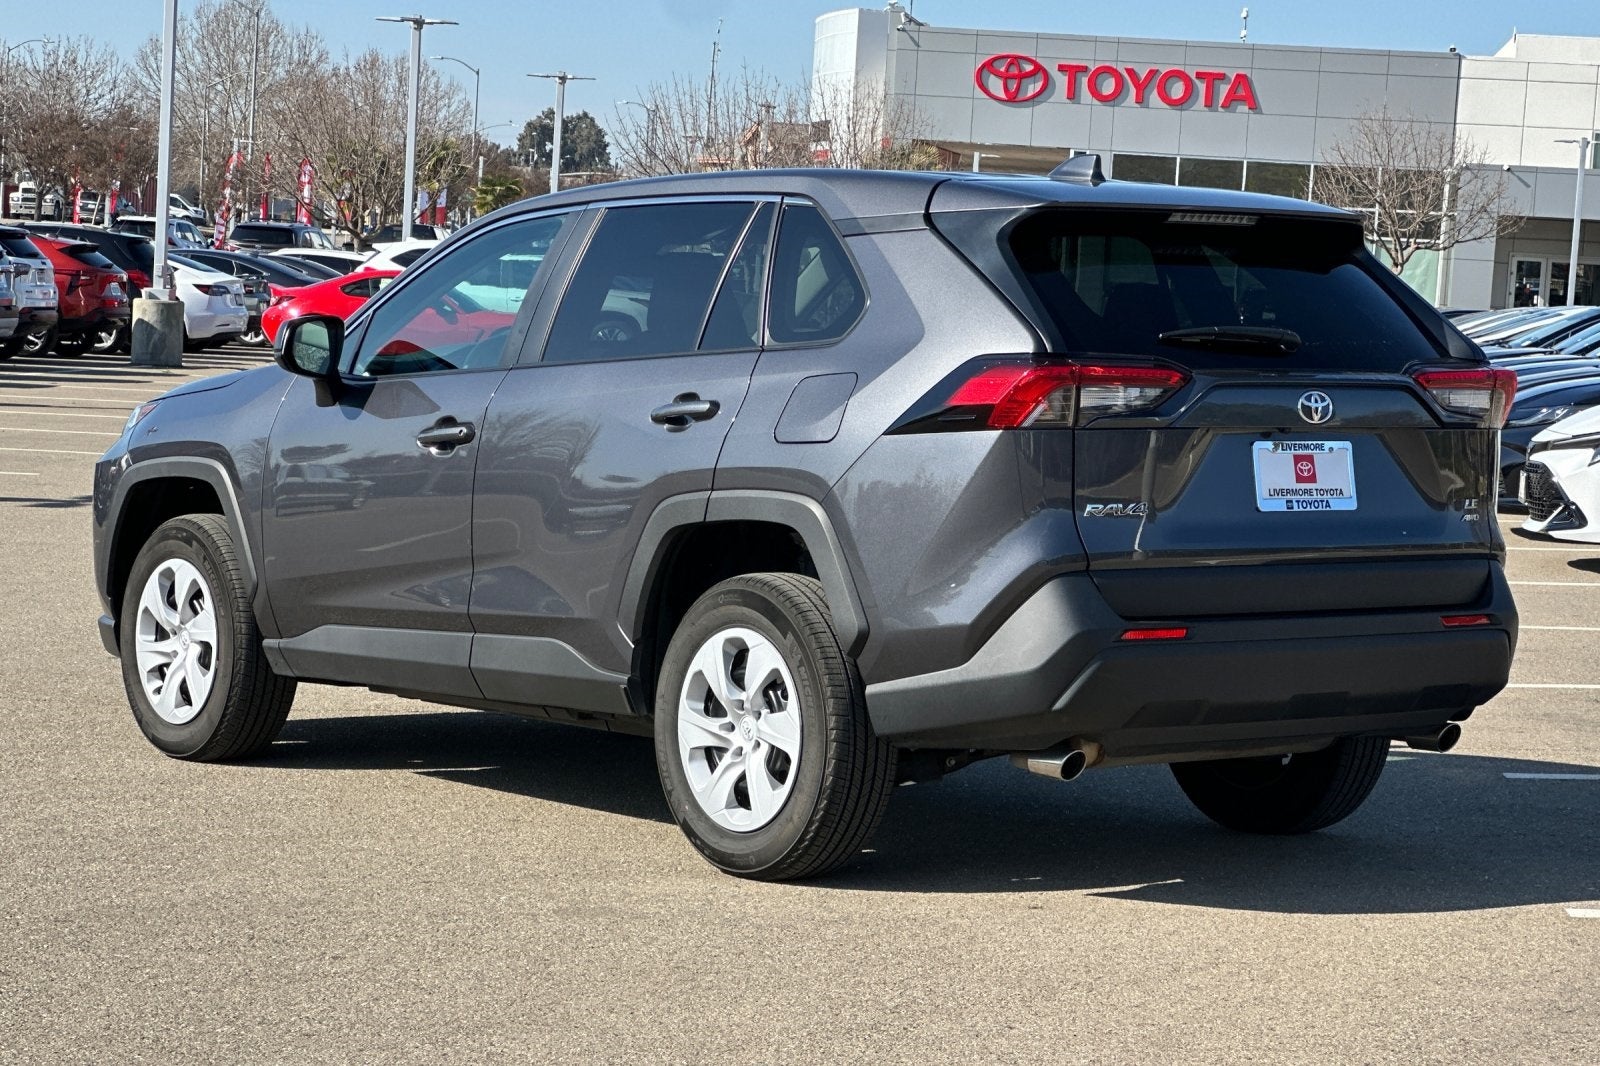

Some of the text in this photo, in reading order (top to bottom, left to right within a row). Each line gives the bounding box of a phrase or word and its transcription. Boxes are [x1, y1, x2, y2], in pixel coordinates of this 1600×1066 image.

[1057, 63, 1257, 110] TOYOTA
[1280, 442, 1325, 452] LIVERMORE
[1268, 488, 1344, 497] LIVERMORE TOYOTA
[1083, 501, 1149, 517] RAV4
[1295, 499, 1331, 510] TOYOTA
[1464, 498, 1479, 510] LE
